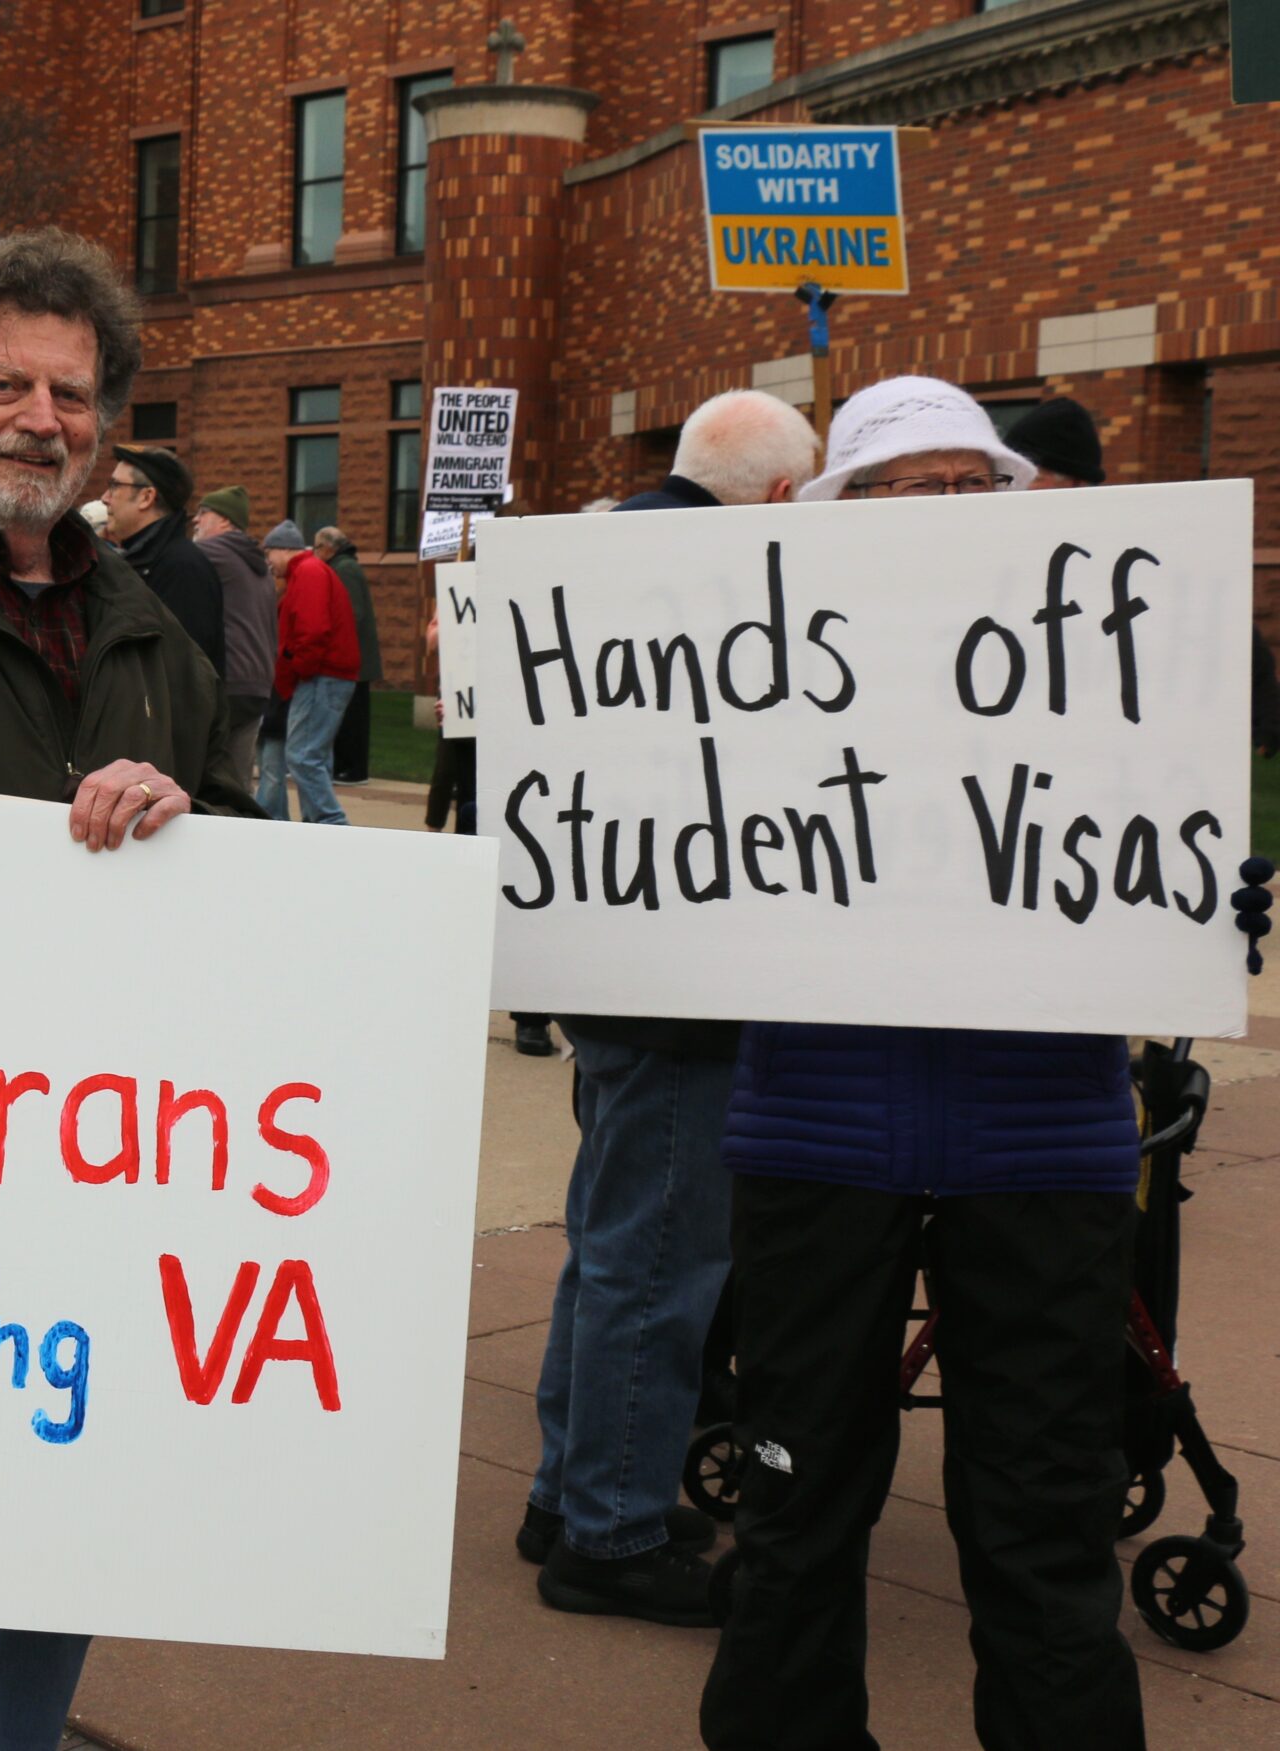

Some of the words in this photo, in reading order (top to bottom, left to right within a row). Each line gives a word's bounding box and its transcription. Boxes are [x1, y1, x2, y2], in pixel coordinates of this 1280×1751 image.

[715, 143, 880, 170] SOLIDARITY
[757, 177, 840, 204] WITH
[723, 227, 890, 266] UKRAINE
[441, 393, 462, 407] THE
[467, 394, 511, 408] PEOPLE
[438, 410, 510, 433] UNITED
[437, 433, 462, 446] WILL
[466, 434, 507, 447] DEFEND
[433, 456, 505, 471] IMMIGRANT
[432, 473, 503, 490] FAMILIES!
[509, 541, 856, 725] Hands
[955, 542, 1160, 724] off
[501, 737, 887, 911] Student
[961, 764, 1222, 925] Visas
[159, 1253, 341, 1412] VA
